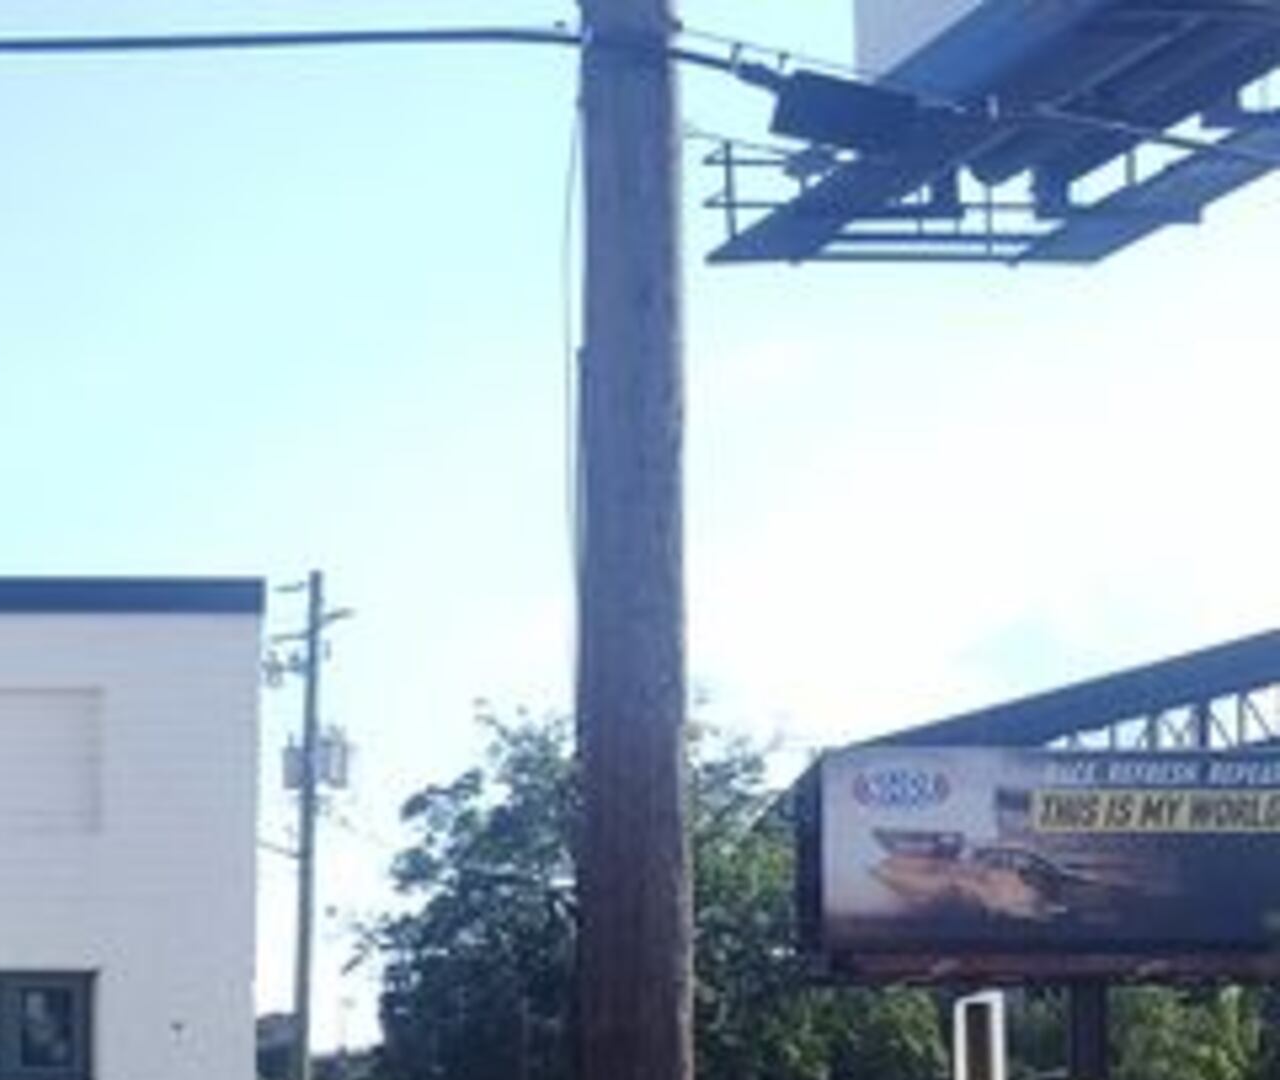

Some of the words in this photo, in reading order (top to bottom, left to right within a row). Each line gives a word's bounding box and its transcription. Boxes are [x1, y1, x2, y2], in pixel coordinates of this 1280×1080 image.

[1040, 796, 1099, 826] THIS
[1104, 796, 1132, 826] IS
[1139, 796, 1183, 826] MY
